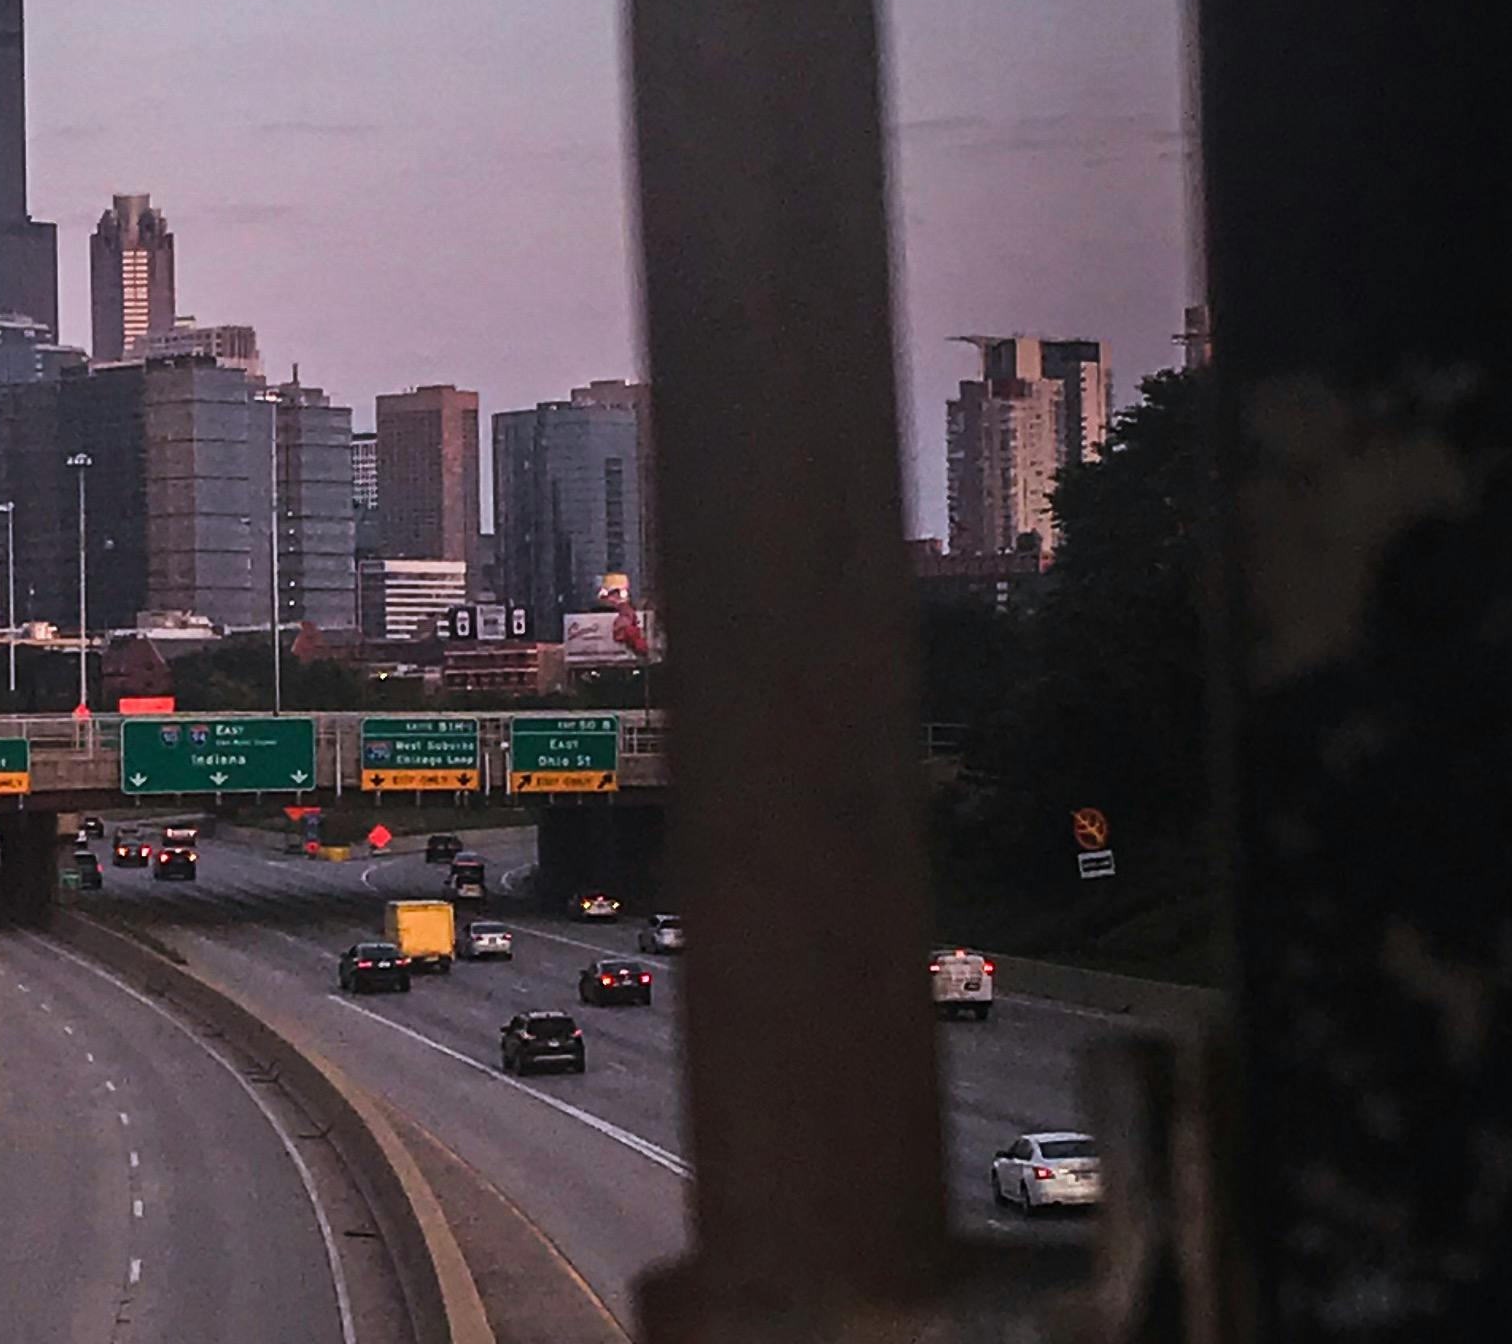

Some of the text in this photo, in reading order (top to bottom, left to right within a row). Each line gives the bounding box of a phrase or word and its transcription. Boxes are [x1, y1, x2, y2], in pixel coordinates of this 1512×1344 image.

[191, 754, 247, 766] Indiana
[538, 755, 591, 767] Ohio St
